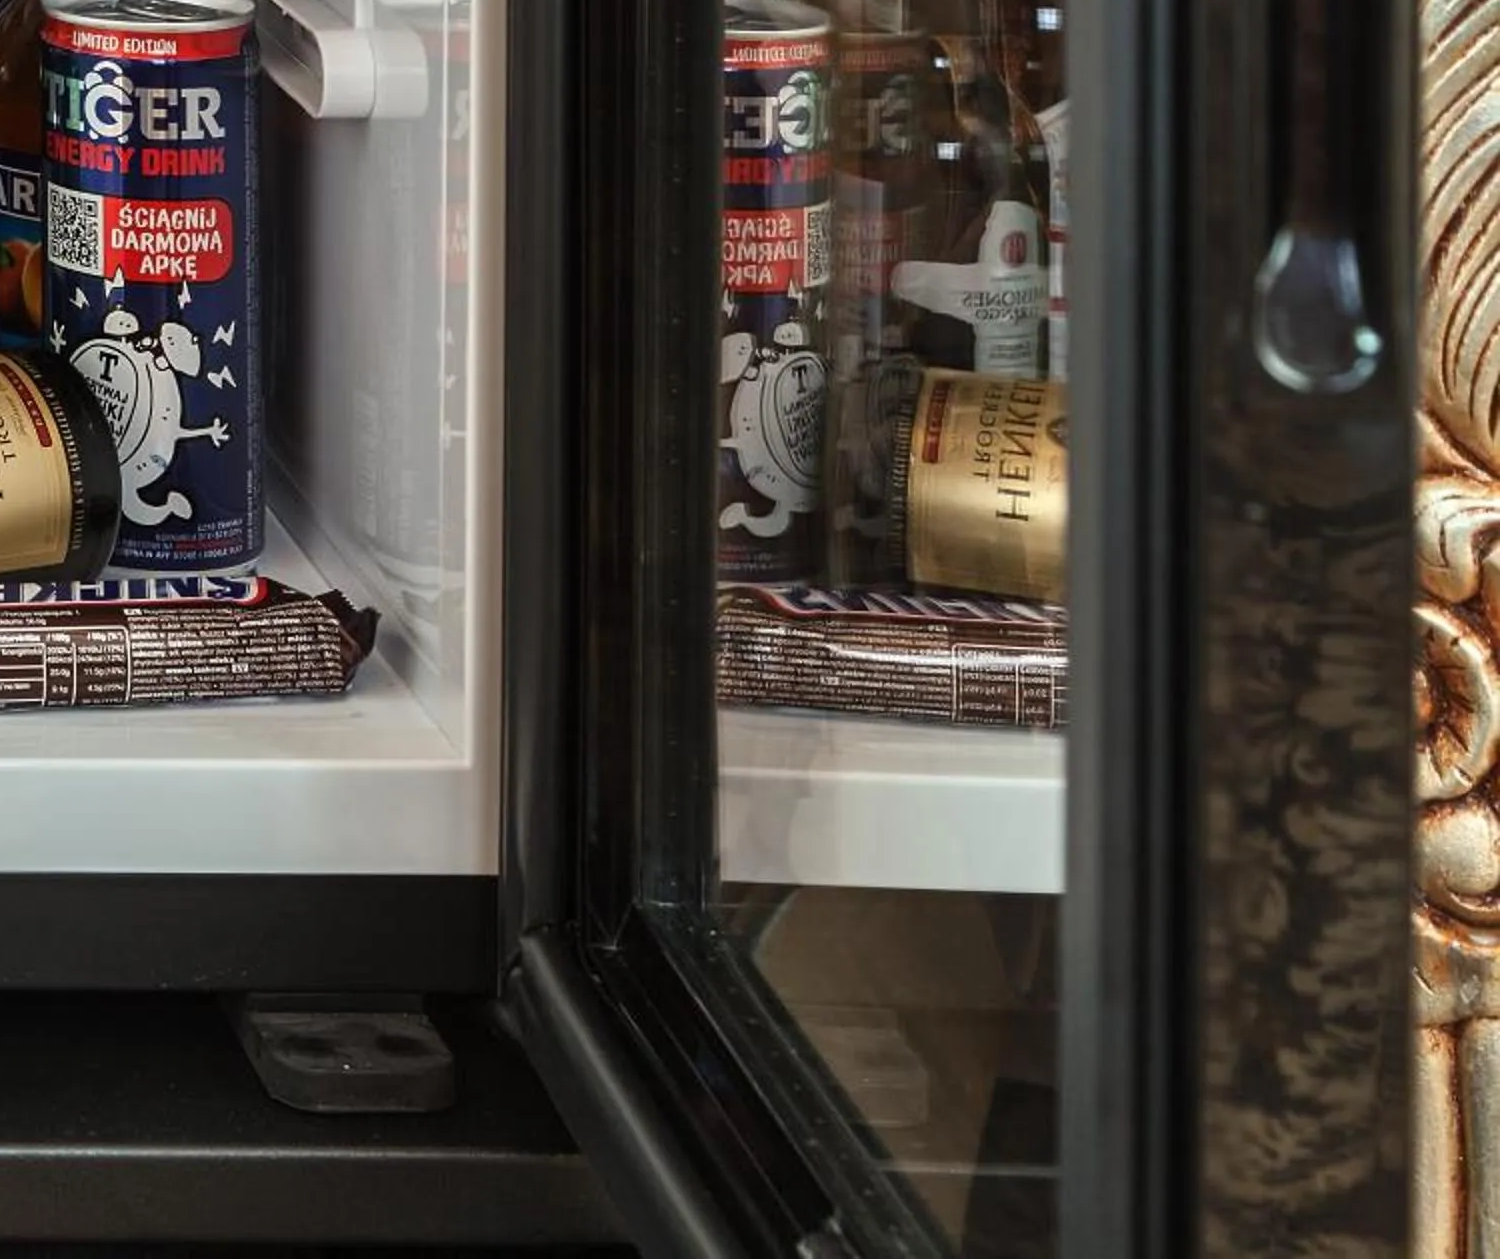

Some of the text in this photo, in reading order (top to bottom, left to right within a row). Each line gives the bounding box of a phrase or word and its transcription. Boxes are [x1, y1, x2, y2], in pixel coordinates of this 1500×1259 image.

[72, 31, 177, 56] LIMITED EDITION
[45, 69, 226, 142] TIGER
[47, 136, 226, 177] ENERGY DRINK
[111, 228, 223, 255] DARMOWĄ
[139, 256, 198, 280] APKĘ
[99, 351, 119, 383] T
